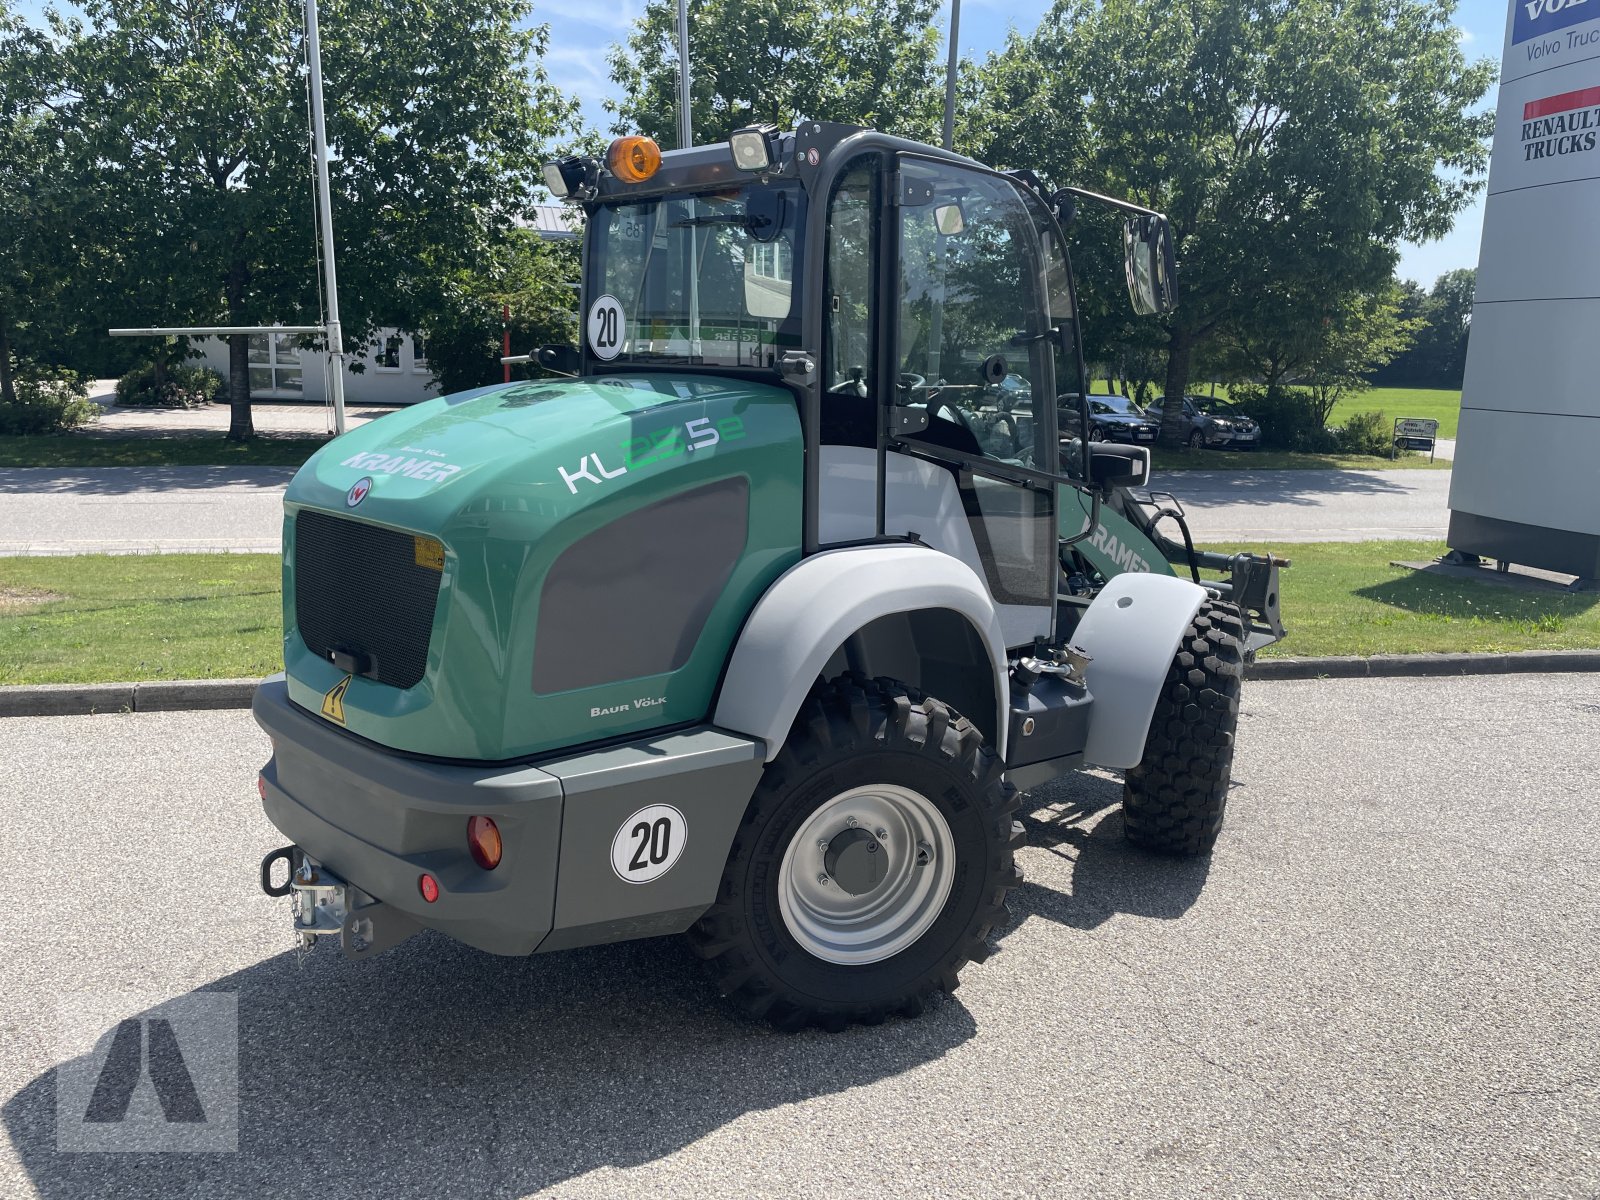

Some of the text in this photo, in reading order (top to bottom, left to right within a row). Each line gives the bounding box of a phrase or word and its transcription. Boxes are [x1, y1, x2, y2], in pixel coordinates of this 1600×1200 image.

[1527, 40, 1561, 61] Volvo
[1524, 131, 1597, 161] TRUCKS
[597, 307, 617, 348] 20
[340, 451, 462, 483] KRAMER
[628, 817, 672, 872] 20
